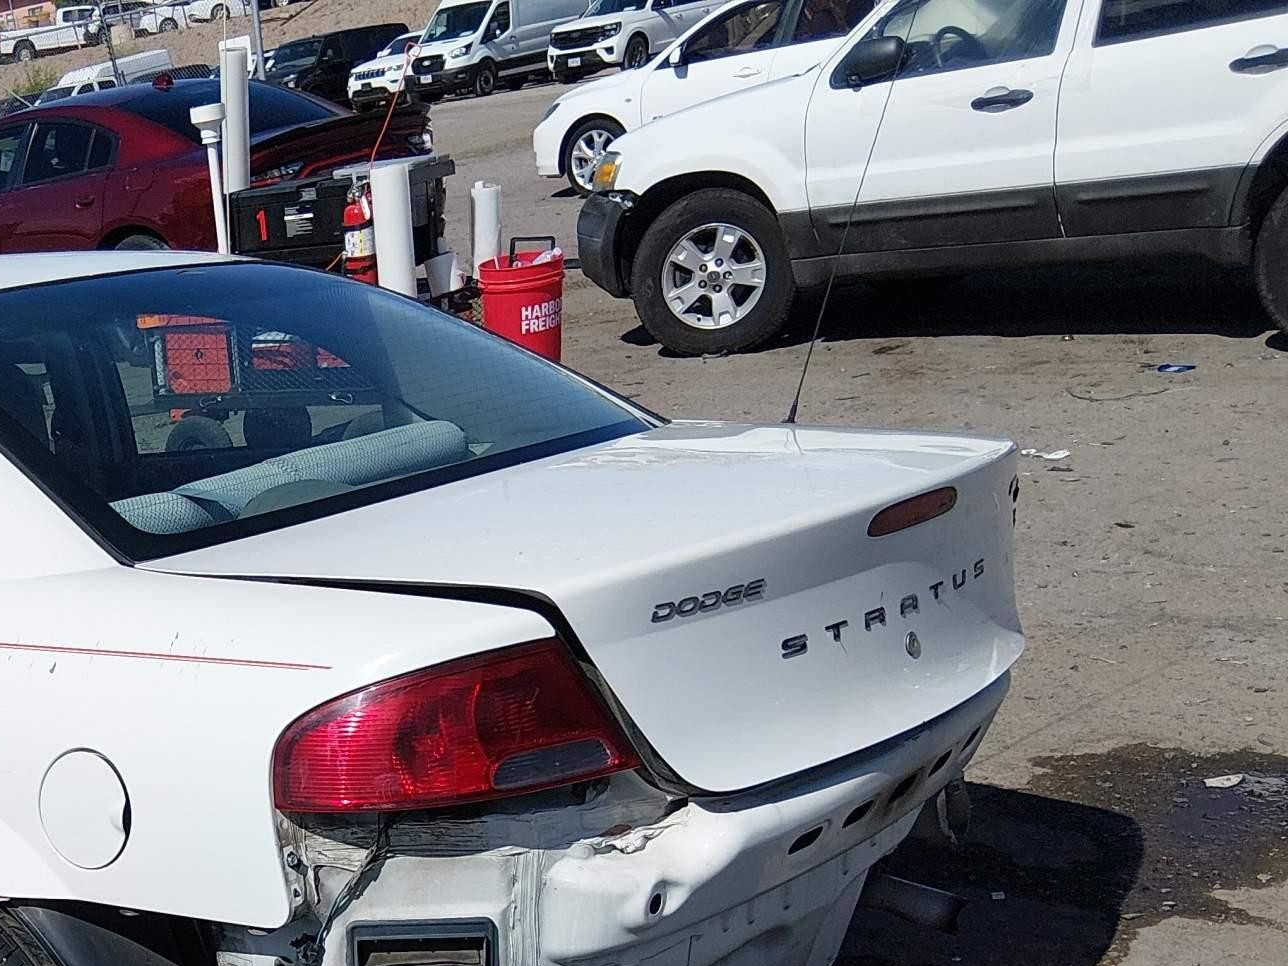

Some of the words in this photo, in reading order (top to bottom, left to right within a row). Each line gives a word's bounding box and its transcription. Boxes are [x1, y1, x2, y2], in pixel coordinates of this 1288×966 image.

[256, 207, 267, 240] 1
[521, 298, 562, 321] HARBO
[521, 313, 561, 335] FREIGH
[650, 578, 768, 624] DODGE
[780, 557, 986, 660] STRATUS
